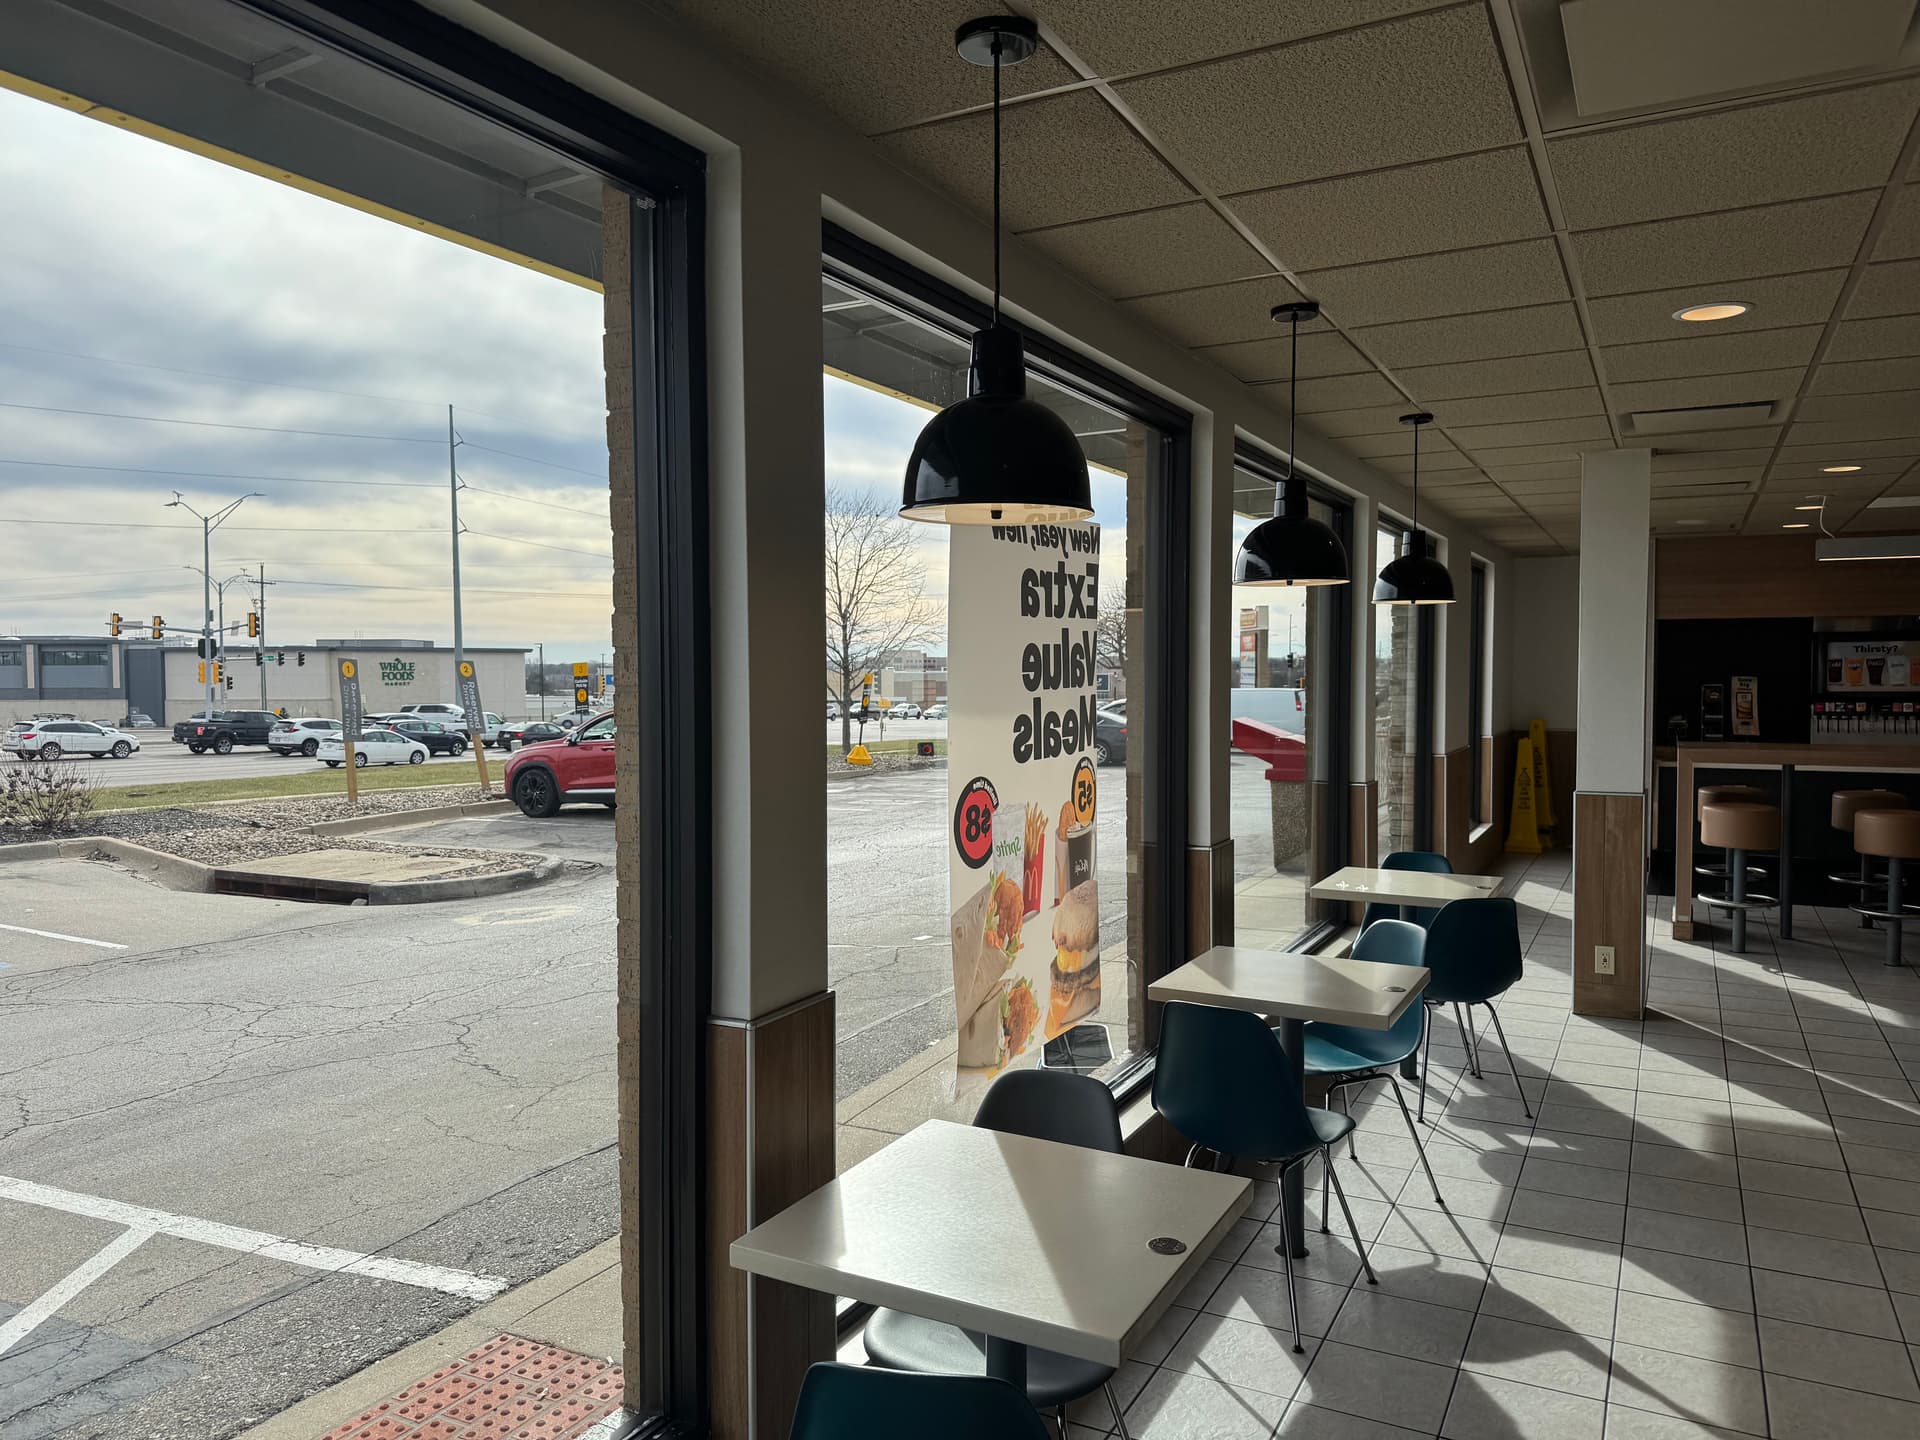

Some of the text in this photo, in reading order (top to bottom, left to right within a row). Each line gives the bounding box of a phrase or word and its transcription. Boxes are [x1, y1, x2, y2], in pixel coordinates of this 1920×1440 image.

[1854, 645, 1898, 655] Thirsty?
[379, 661, 416, 671] WHOLE
[381, 671, 415, 681] FOODS
[462, 684, 470, 706] Drive
[467, 681, 482, 729] Reserved
